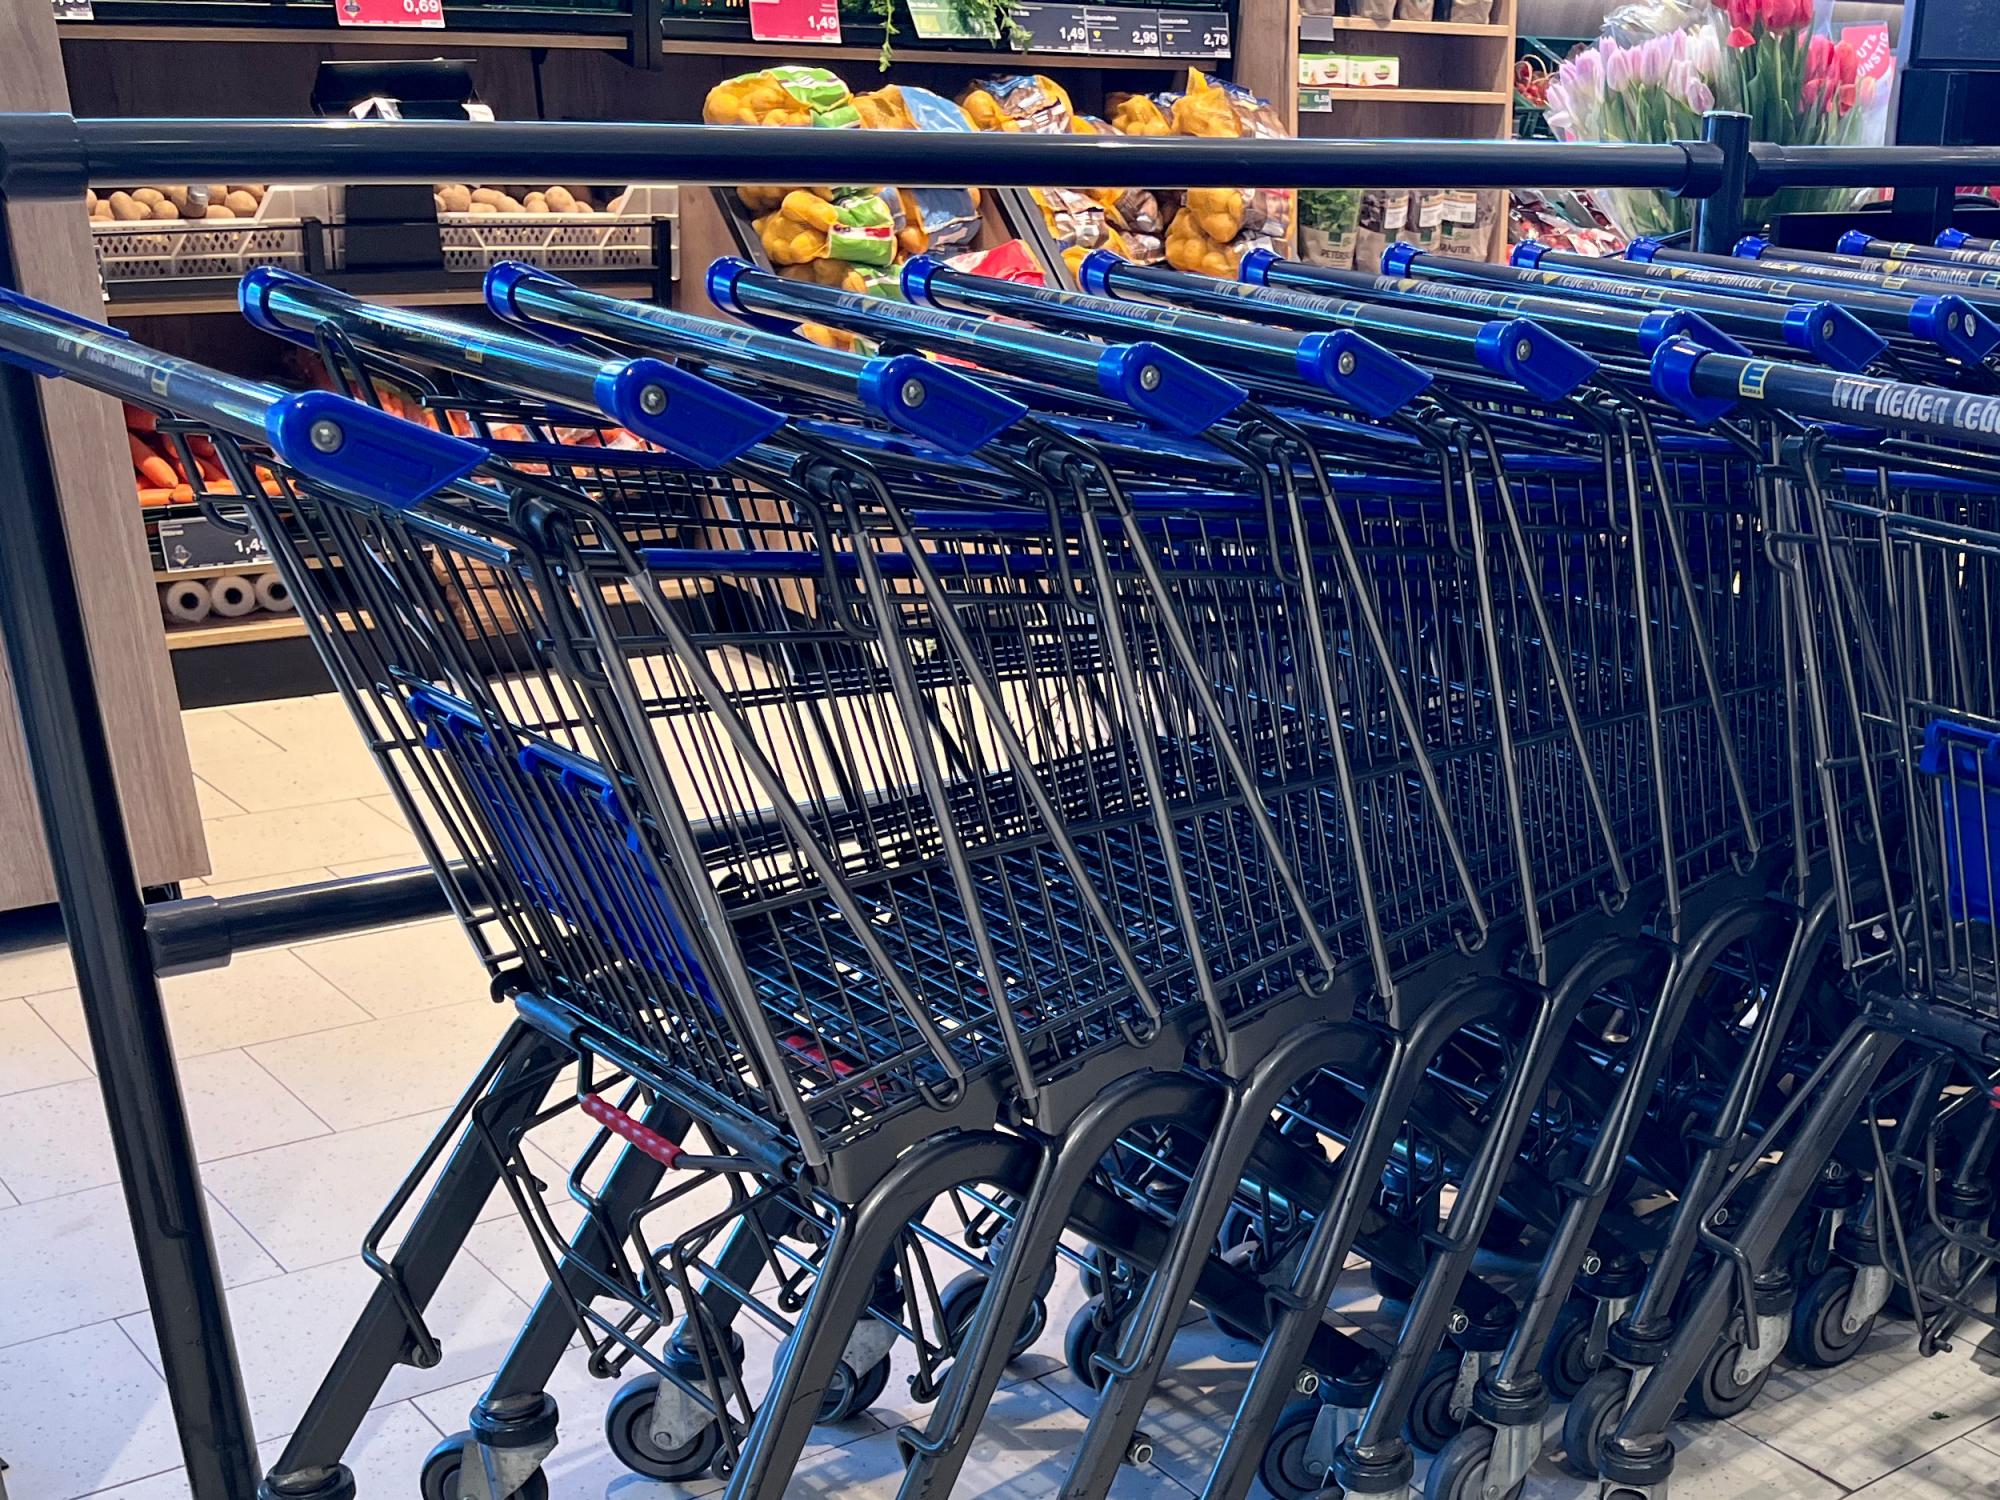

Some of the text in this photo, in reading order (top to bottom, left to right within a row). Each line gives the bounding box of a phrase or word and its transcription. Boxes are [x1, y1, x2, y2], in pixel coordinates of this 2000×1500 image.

[403, 0, 439, 15] 0,69
[808, 15, 837, 31] 1,49
[1059, 26, 1086, 42] 1,49
[1132, 31, 1158, 45] 2,99
[1203, 33, 1229, 47] 2,79
[1832, 375, 2000, 437] Wir lieben Leb
